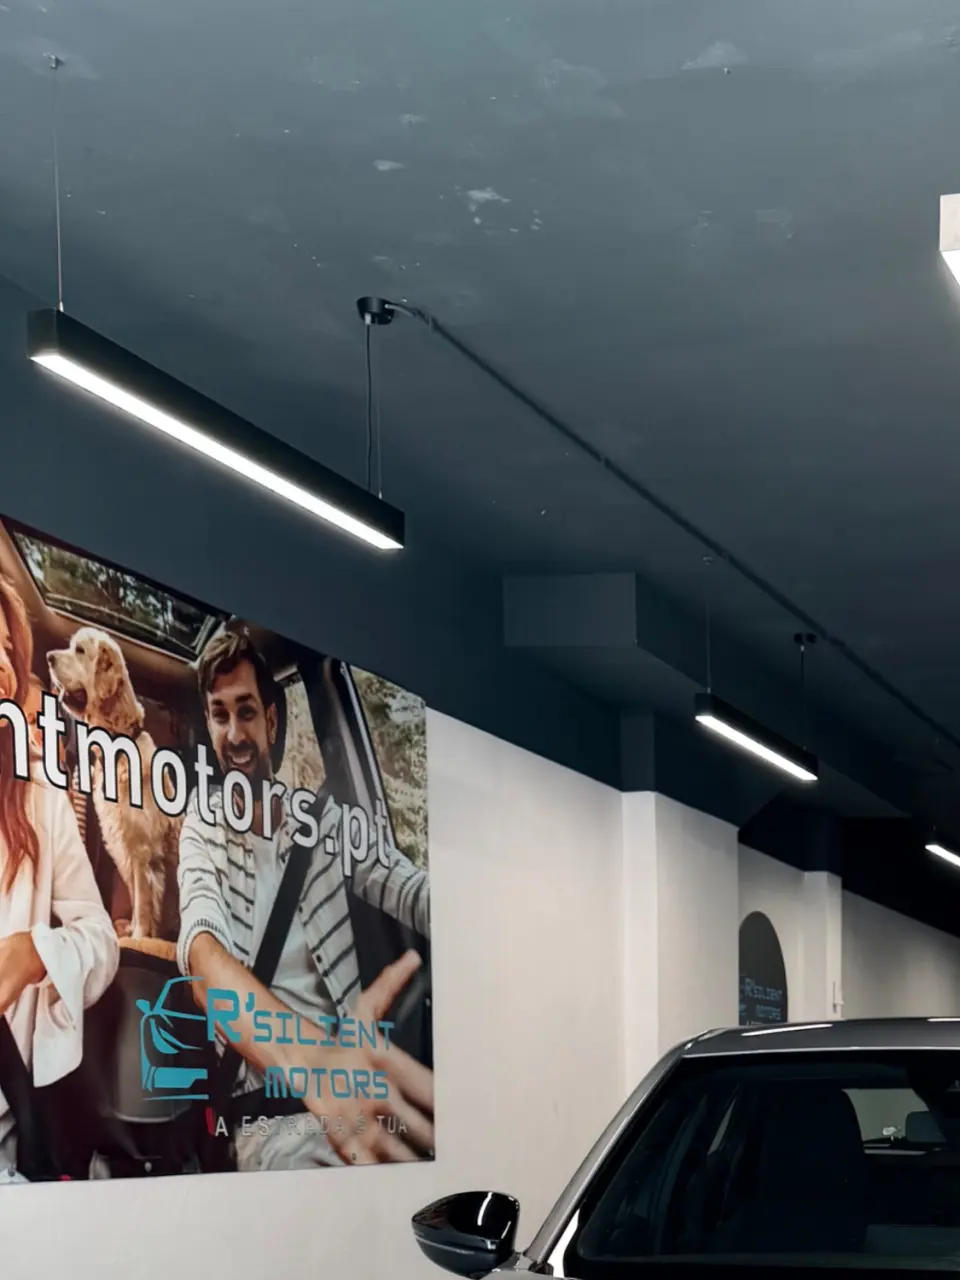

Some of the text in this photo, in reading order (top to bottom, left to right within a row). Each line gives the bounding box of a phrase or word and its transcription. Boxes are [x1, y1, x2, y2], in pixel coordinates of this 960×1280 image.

[206, 988, 395, 1050] R'SILIENT
[265, 1066, 389, 1100] MOTORS
[215, 1116, 228, 1137] A
[241, 1115, 343, 1136] ESTRADA
[376, 1115, 408, 1133] TUA
